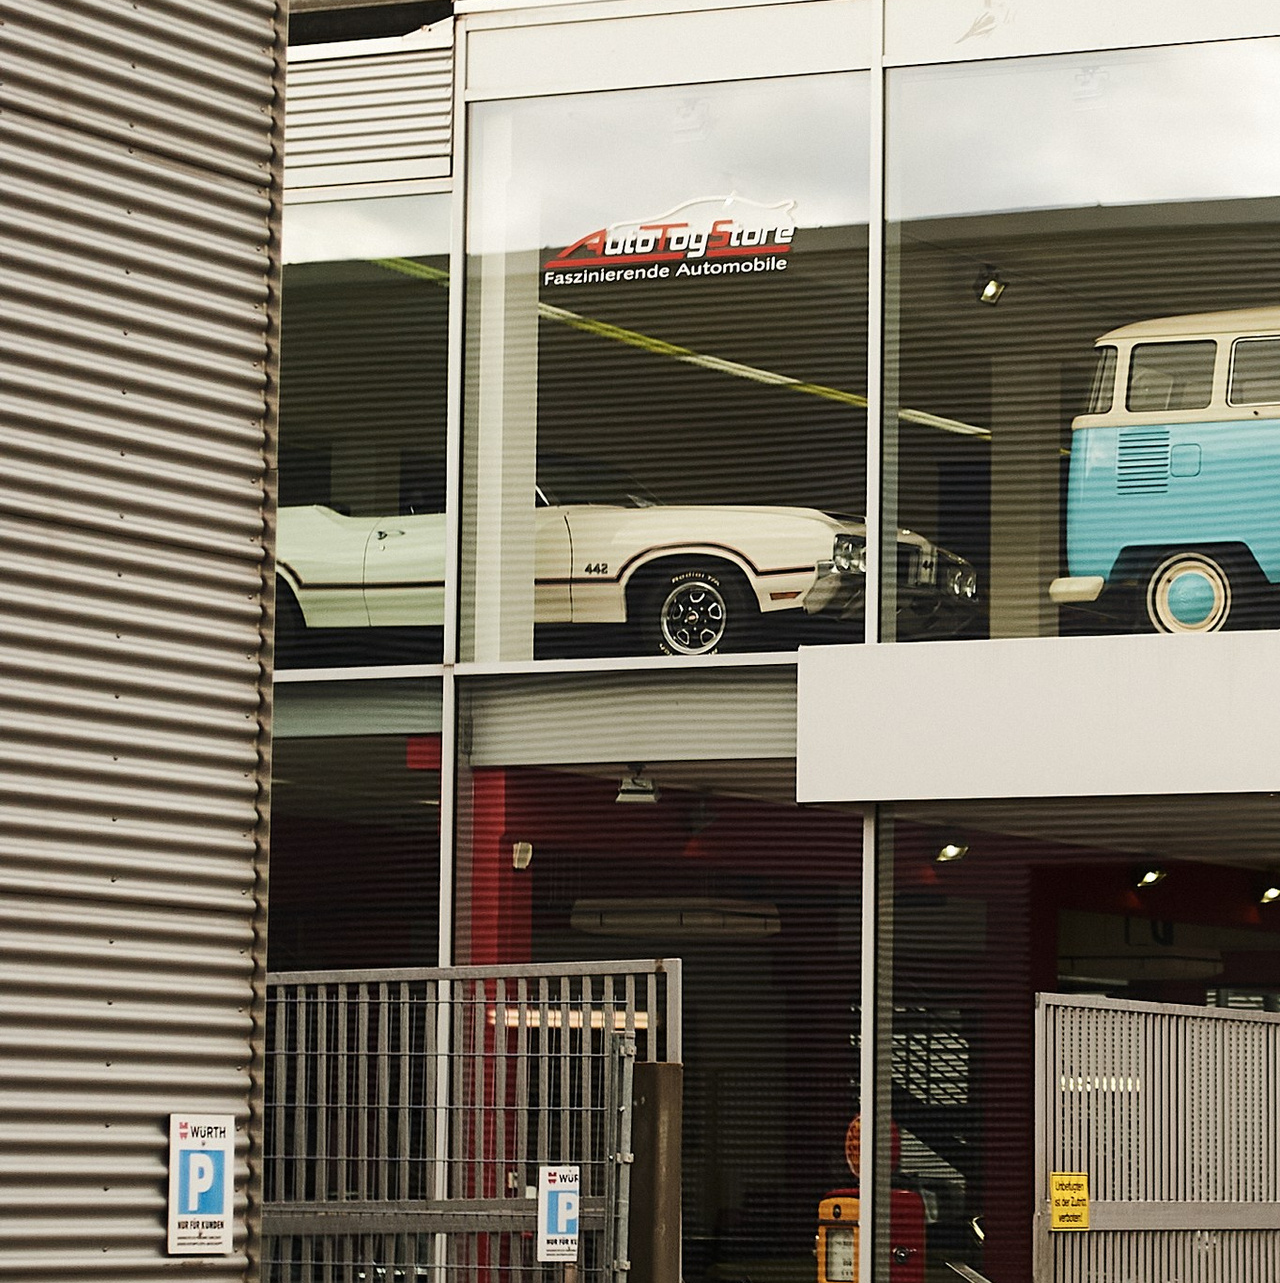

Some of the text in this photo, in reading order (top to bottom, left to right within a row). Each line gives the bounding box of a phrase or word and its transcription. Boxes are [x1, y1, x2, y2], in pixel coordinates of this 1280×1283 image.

[557, 220, 796, 259] AutoToyStore
[544, 256, 787, 286] Faszinierende Automobile
[584, 563, 608, 575] 442
[190, 1125, 227, 1139] WÜRTH
[187, 1152, 214, 1212] P
[177, 1218, 224, 1230] NUR FÜR KUNDEN
[557, 1192, 578, 1233] P
